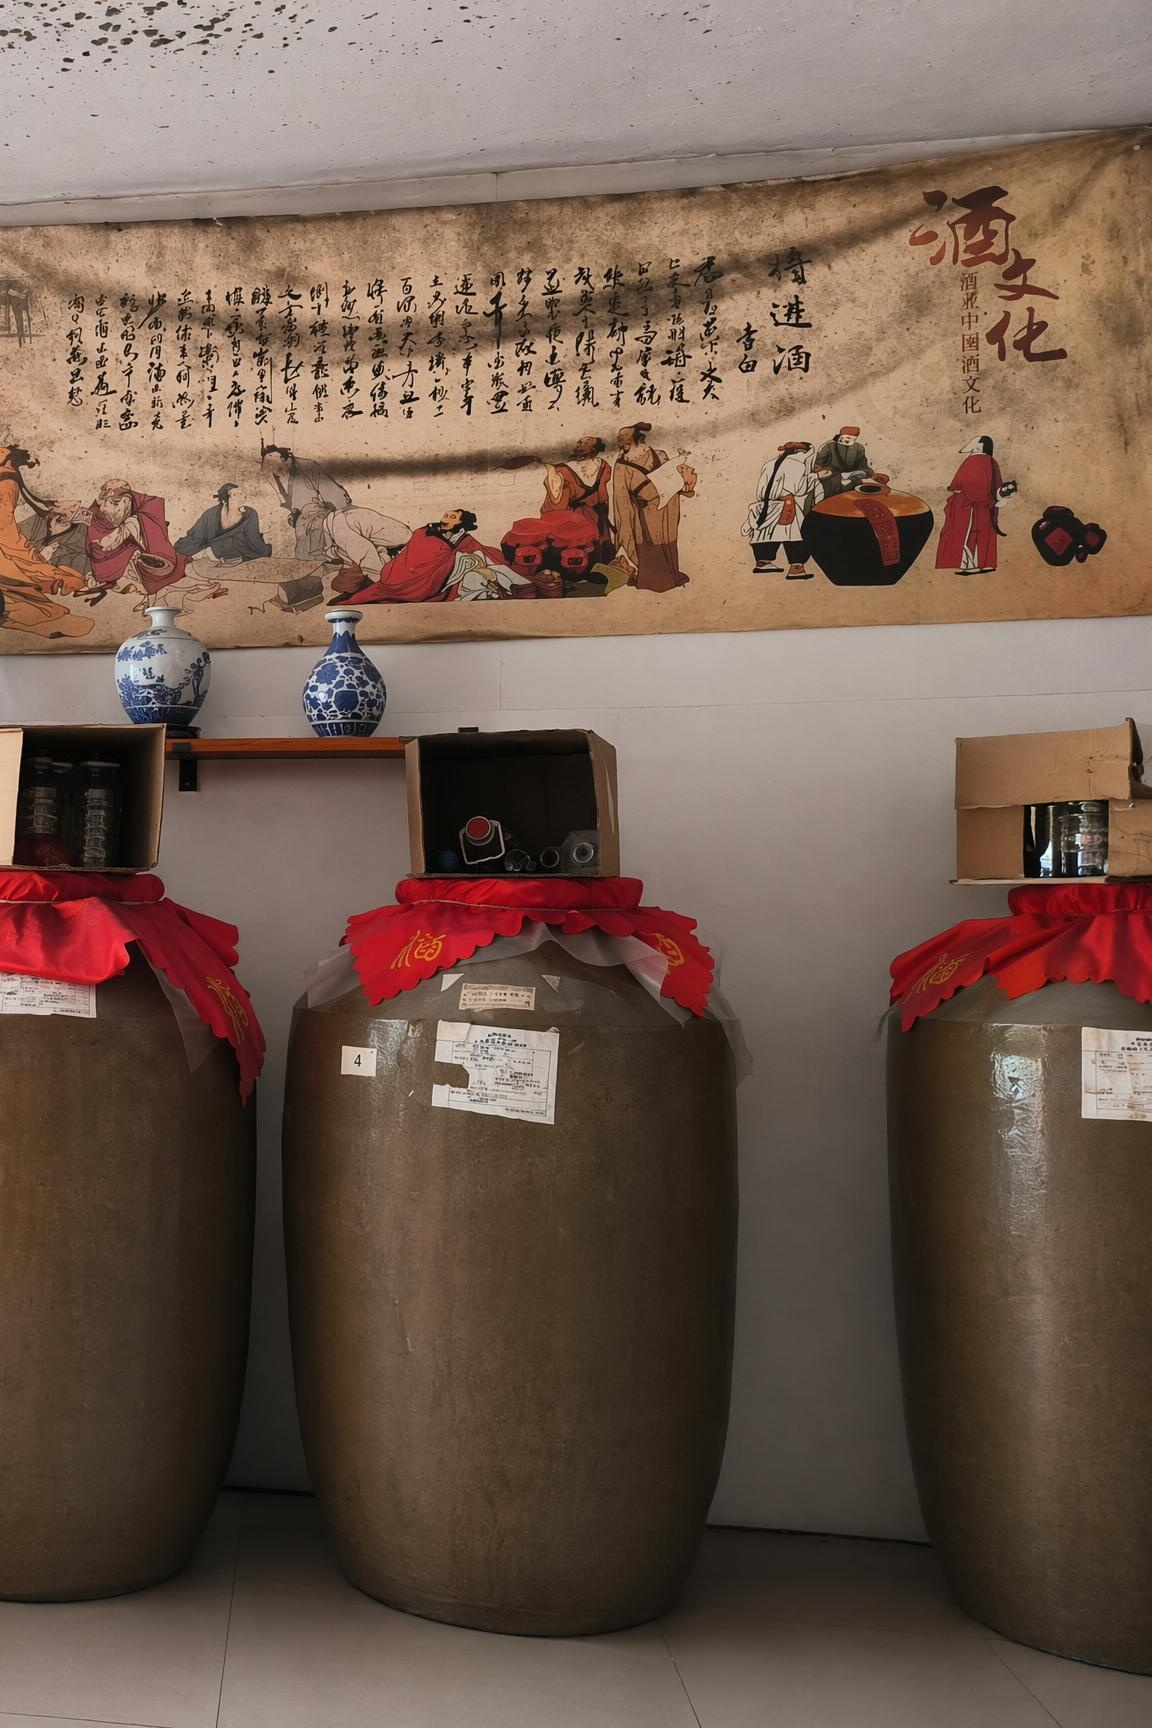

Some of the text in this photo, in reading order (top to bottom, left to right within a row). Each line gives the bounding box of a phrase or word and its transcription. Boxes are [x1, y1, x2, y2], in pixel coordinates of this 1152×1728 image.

[909, 185, 1068, 363] 酒文化
[736, 321, 758, 374] 李白
[352, 1054, 363, 1070] 4
